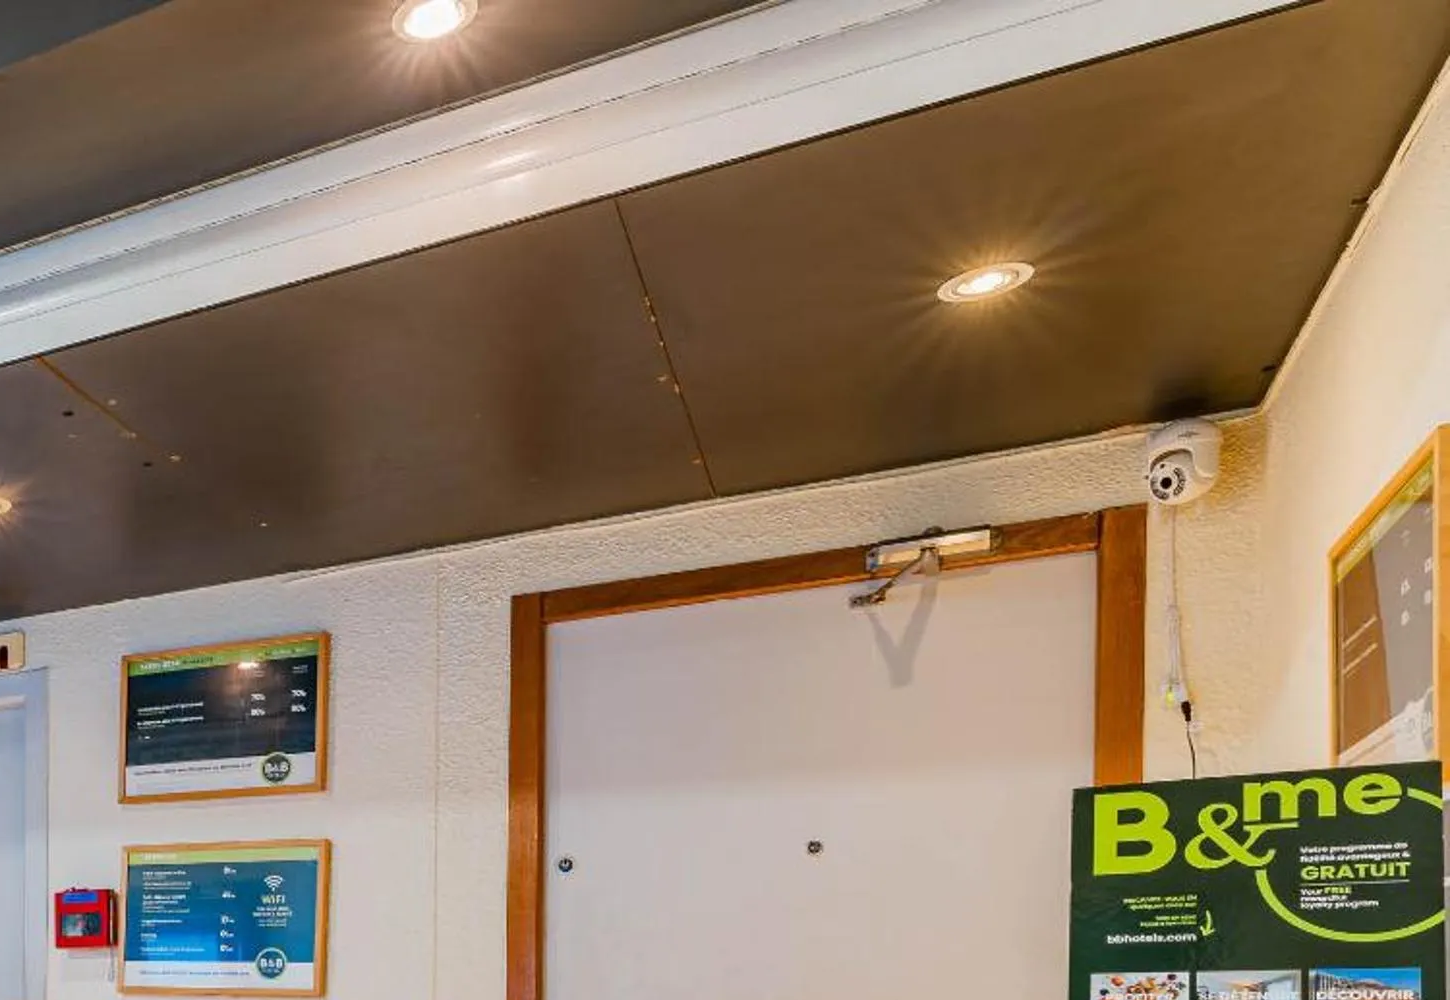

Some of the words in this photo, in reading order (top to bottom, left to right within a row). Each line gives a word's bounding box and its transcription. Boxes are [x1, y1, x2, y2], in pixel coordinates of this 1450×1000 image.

[1301, 862, 1411, 880] GRATUIT
[1107, 933, 1197, 944] bbhotels.com
[1316, 987, 1415, 1000] DÉCOUVRIR
